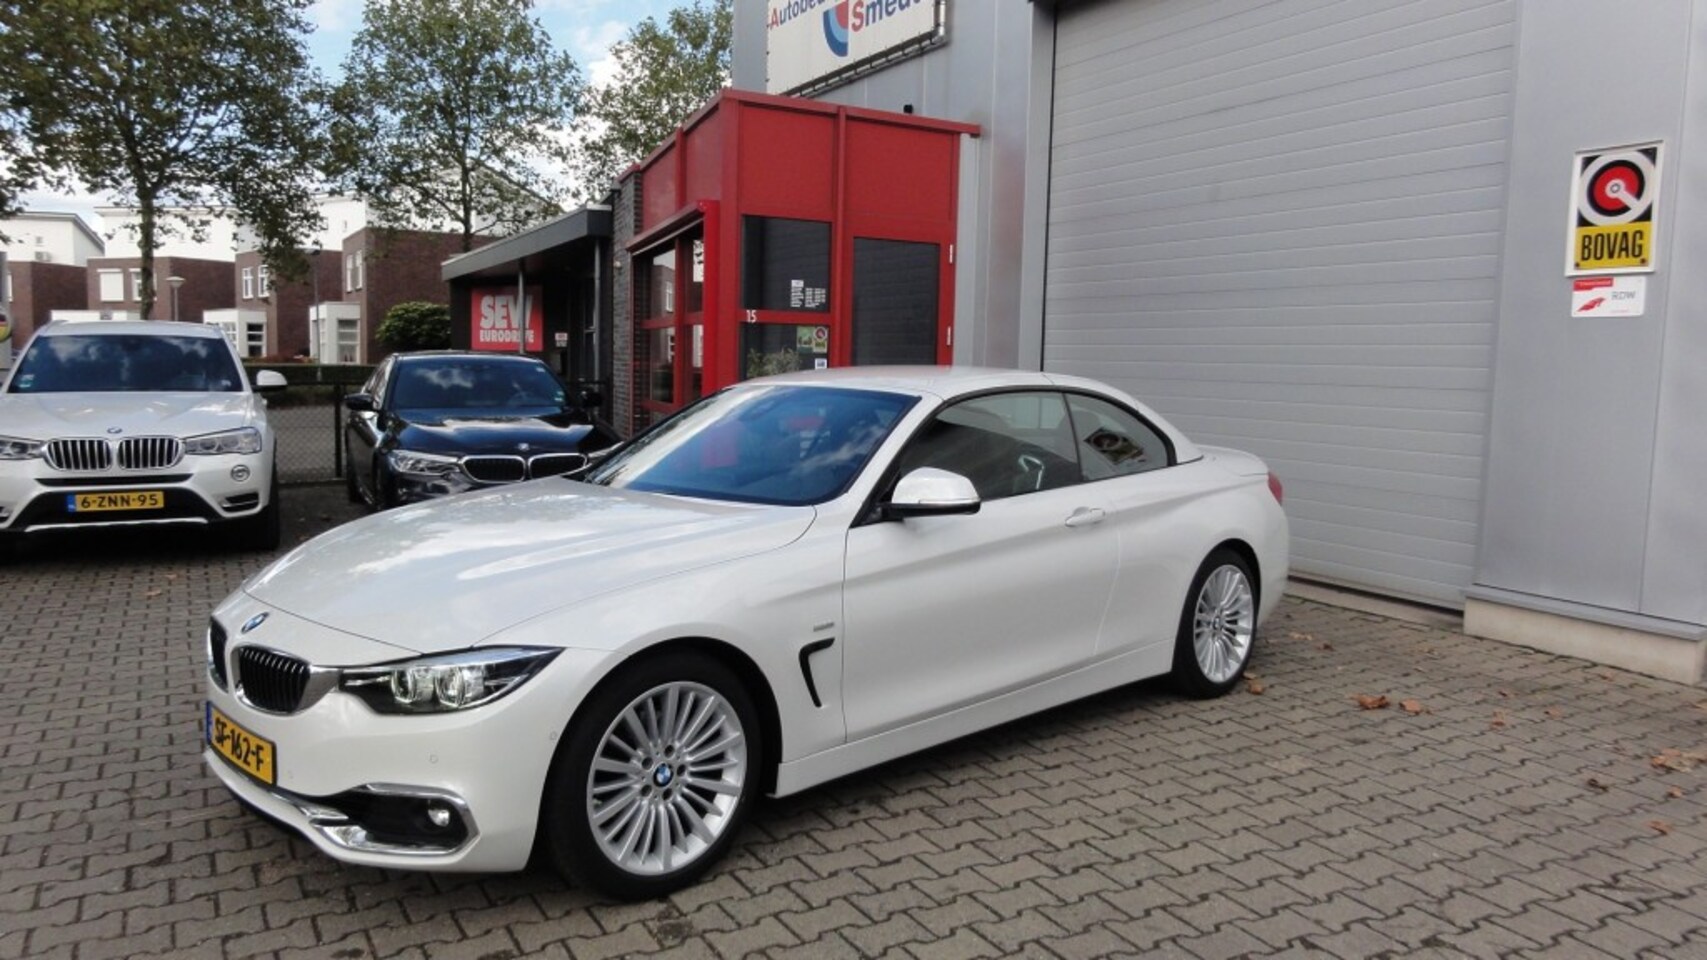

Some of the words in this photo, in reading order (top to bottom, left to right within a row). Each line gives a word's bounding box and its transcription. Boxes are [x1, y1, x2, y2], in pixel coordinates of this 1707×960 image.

[1580, 230, 1644, 261] BOVAG
[1611, 290, 1636, 300] RDW
[746, 309, 757, 323] 15
[81, 493, 159, 509] 6-ZNN-95
